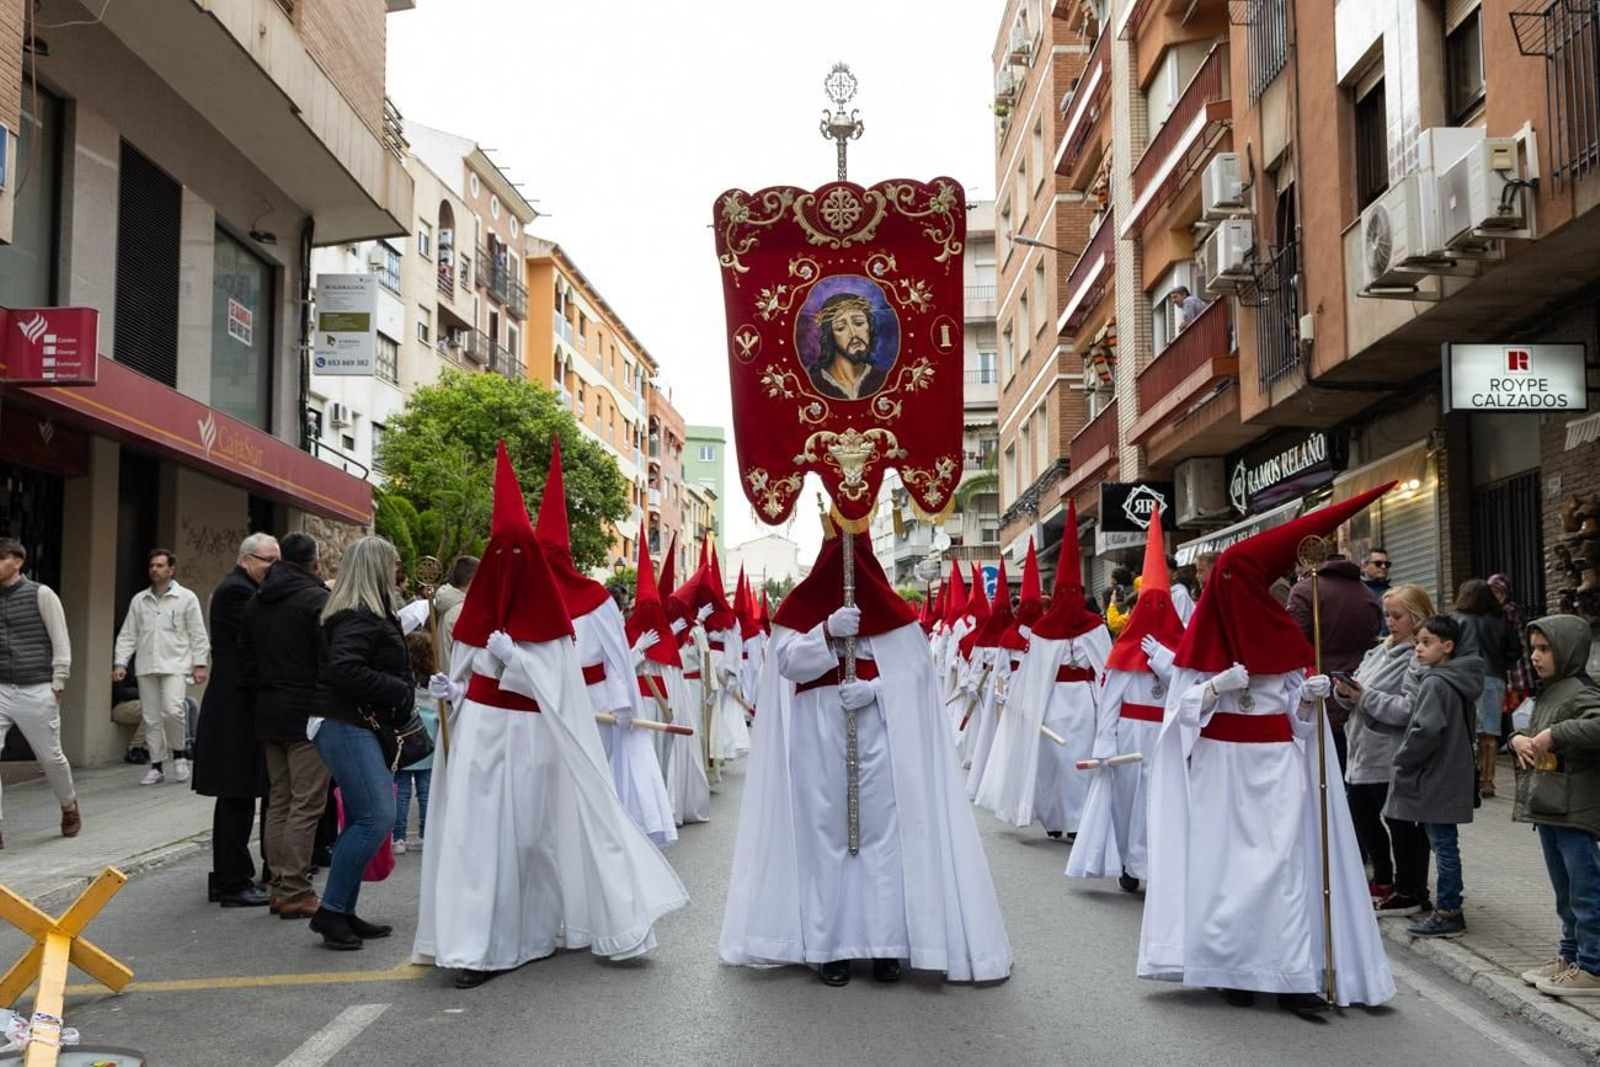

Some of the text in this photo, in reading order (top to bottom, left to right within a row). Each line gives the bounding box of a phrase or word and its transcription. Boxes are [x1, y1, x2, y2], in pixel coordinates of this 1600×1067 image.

[1490, 378, 1548, 392] ROYPE
[1471, 394, 1568, 408] CALZADOS
[1247, 432, 1325, 496] RAMOS RELAÑO
